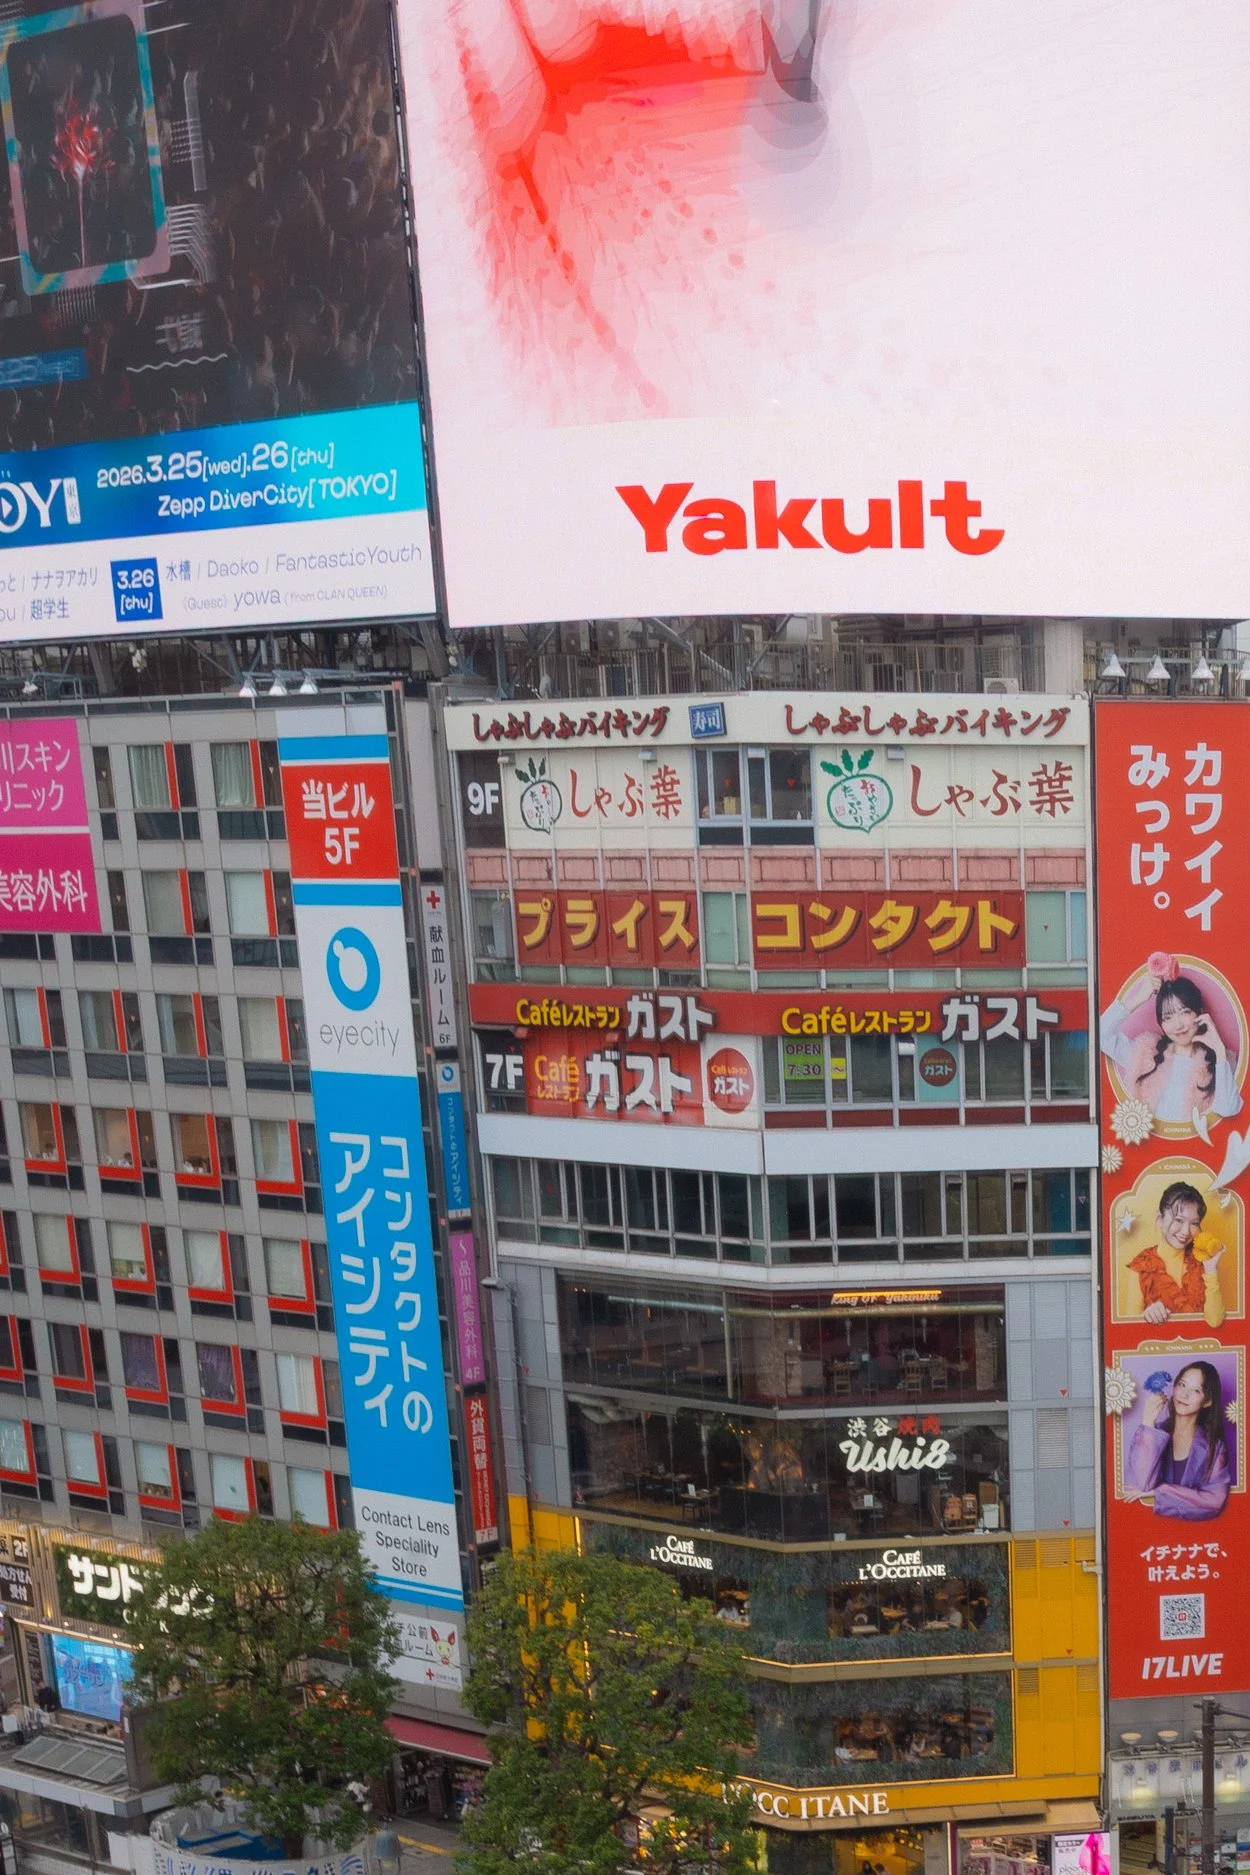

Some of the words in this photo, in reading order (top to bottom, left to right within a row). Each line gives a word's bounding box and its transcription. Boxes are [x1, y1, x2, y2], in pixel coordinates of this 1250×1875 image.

[158, 493, 206, 519] Zepp
[614, 480, 1005, 556] Yakult
[116, 569, 155, 589] 3.26
[166, 560, 191, 582] 水槽
[208, 560, 260, 577] Daoko
[276, 543, 424, 573] FantasticYouth
[31, 598, 71, 620] 超学生
[233, 589, 282, 611] yowa
[316, 588, 346, 602] CLAN
[472, 705, 671, 741] しゃぶしゃぶバイキング
[693, 710, 722, 733] 寿司
[784, 704, 1071, 738] しゃぶしゃぶバイキング
[301, 782, 375, 821] 当ビル
[467, 781, 499, 815] 9F
[570, 764, 683, 820] しゃぶ葉
[910, 760, 1075, 818] しゃぶ葉
[1128, 745, 1171, 909] みっけ。
[1184, 742, 1224, 931] カワイイ
[325, 828, 360, 865] 5F
[518, 899, 696, 949] プライス
[755, 899, 1016, 950] コンタクト
[429, 925, 450, 1026] 献血ルーム
[627, 993, 713, 1042] ガスト
[941, 995, 1059, 1041] ガスト
[319, 1020, 400, 1058] eyecity
[439, 1033, 451, 1044] 6F
[785, 1043, 822, 1055] OPEN
[485, 1053, 523, 1090] 7F
[534, 1055, 580, 1084] Café
[585, 1048, 692, 1113] ガスト
[714, 1076, 750, 1096] ガスト
[788, 1063, 822, 1077] 7:30
[924, 1064, 953, 1077] ガスト
[536, 1083, 580, 1103] レストラン
[329, 1132, 394, 1428] アイシティ
[380, 1135, 433, 1434] コンタクトの
[465, 1367, 481, 1380] 4F
[470, 1400, 487, 1470] 外貨両替
[839, 1437, 950, 1473] Ushi8
[361, 1505, 412, 1529] Contact
[418, 1514, 450, 1536] Lens
[376, 1530, 440, 1558] Speciality
[650, 1547, 713, 1571] L'OCCITANE
[1140, 1542, 1228, 1560] イチナナで、
[391, 1556, 428, 1578] Store
[859, 1564, 947, 1580] L'OCCITANE
[1148, 1564, 1222, 1584] 叶えよう。
[1141, 1654, 1224, 1680] 17LIVE
